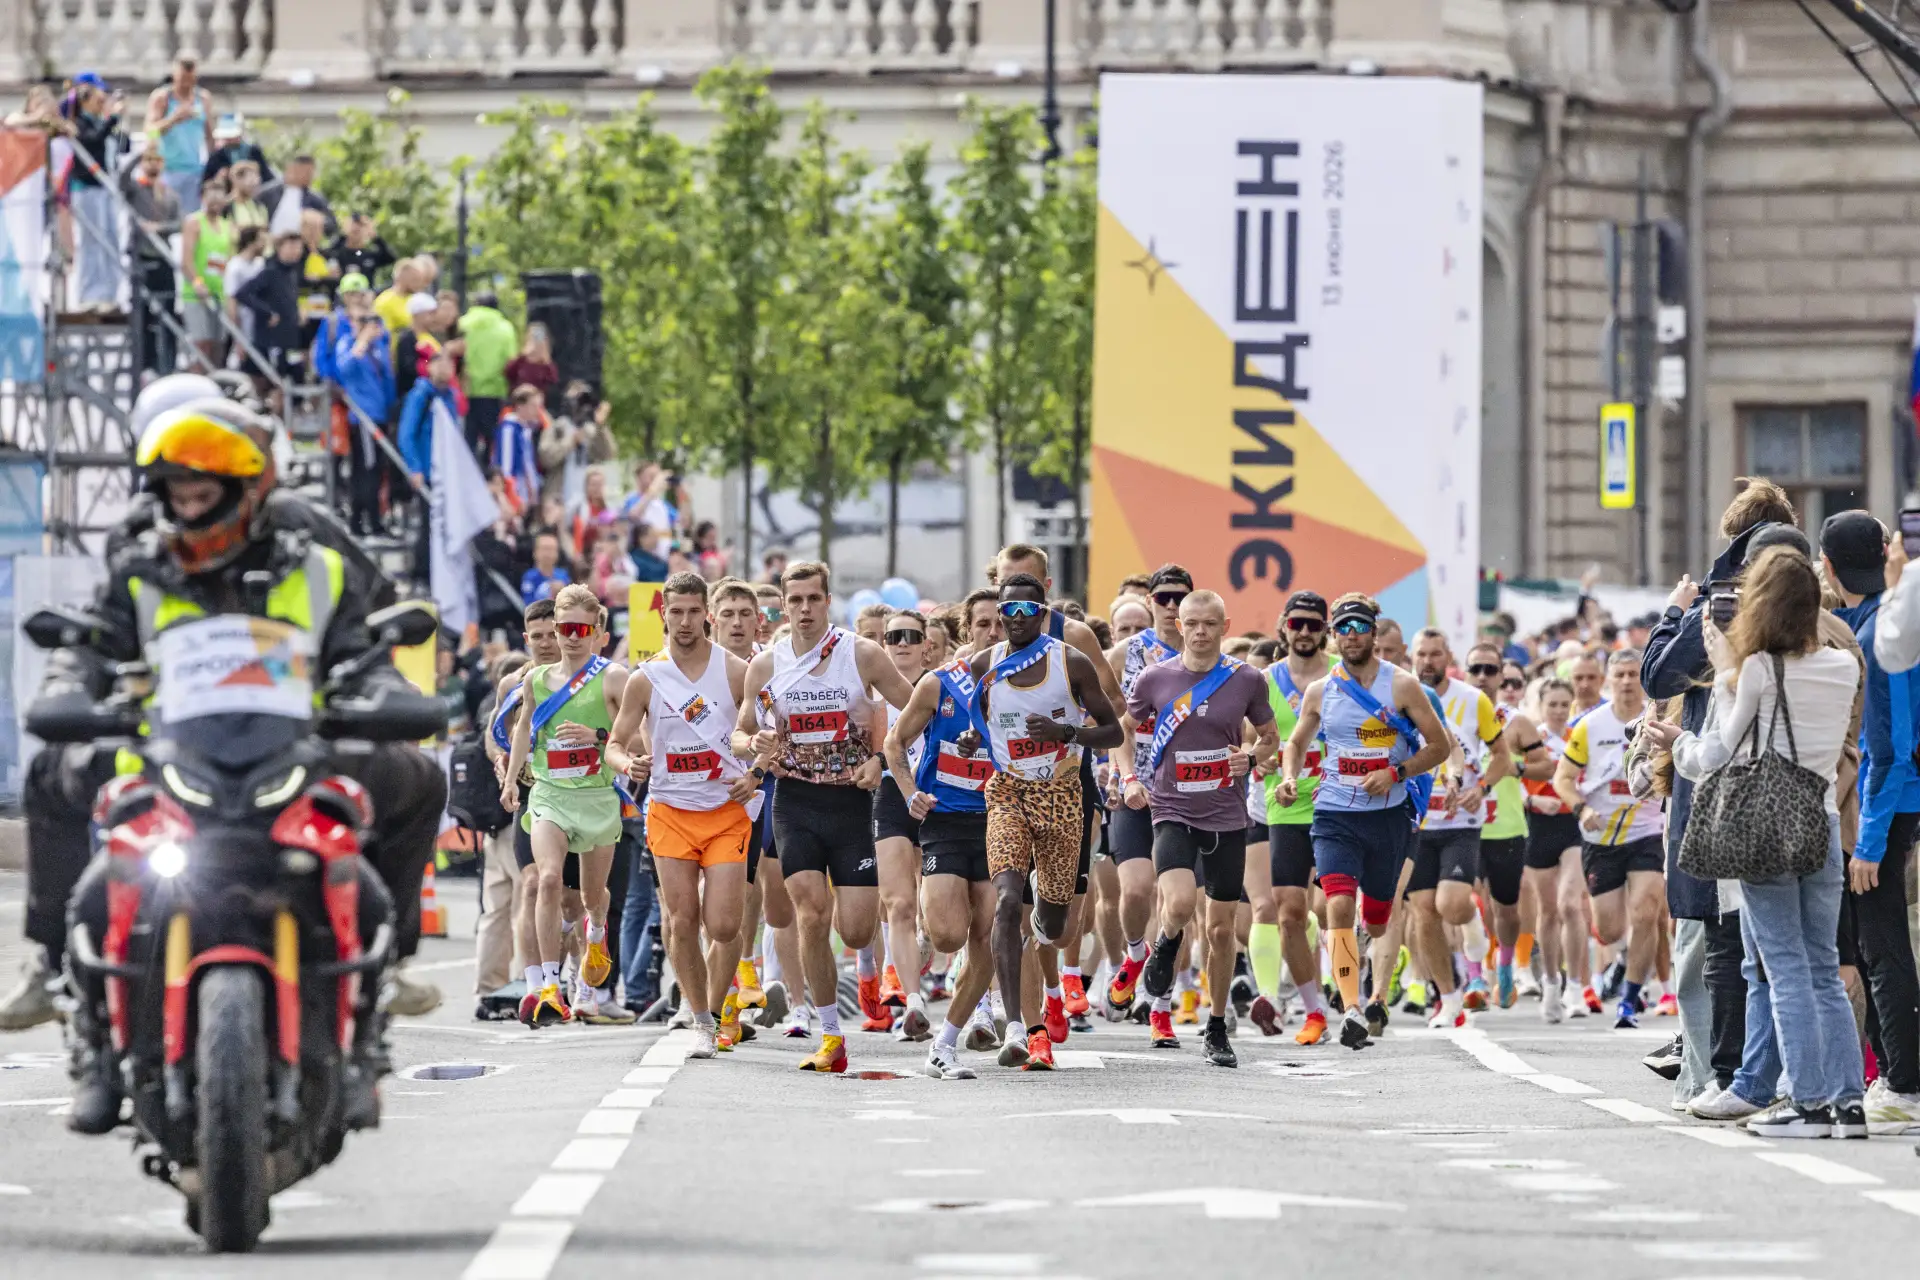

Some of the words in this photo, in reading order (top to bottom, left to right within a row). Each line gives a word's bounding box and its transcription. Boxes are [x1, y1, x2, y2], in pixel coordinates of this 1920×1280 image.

[1323, 139, 1344, 200] 2026
[1326, 207, 1341, 276] июня
[1322, 284, 1342, 305] 13
[1229, 140, 1310, 592] ЭКИДЕН
[678, 692, 700, 713] ЭКИДЕН
[786, 689, 848, 701] РАЗЪБЕГУ
[796, 715, 838, 731] 164-1
[1150, 703, 1192, 763] КИДЕН
[680, 744, 711, 752] ЭКИДЕ
[569, 752, 592, 766] 8-1
[673, 755, 713, 771] 413-1
[1193, 753, 1227, 761] ЭКИДЕН
[966, 762, 987, 779] 1-1
[1183, 765, 1224, 780] 279-1
[1341, 760, 1381, 774] 3061
